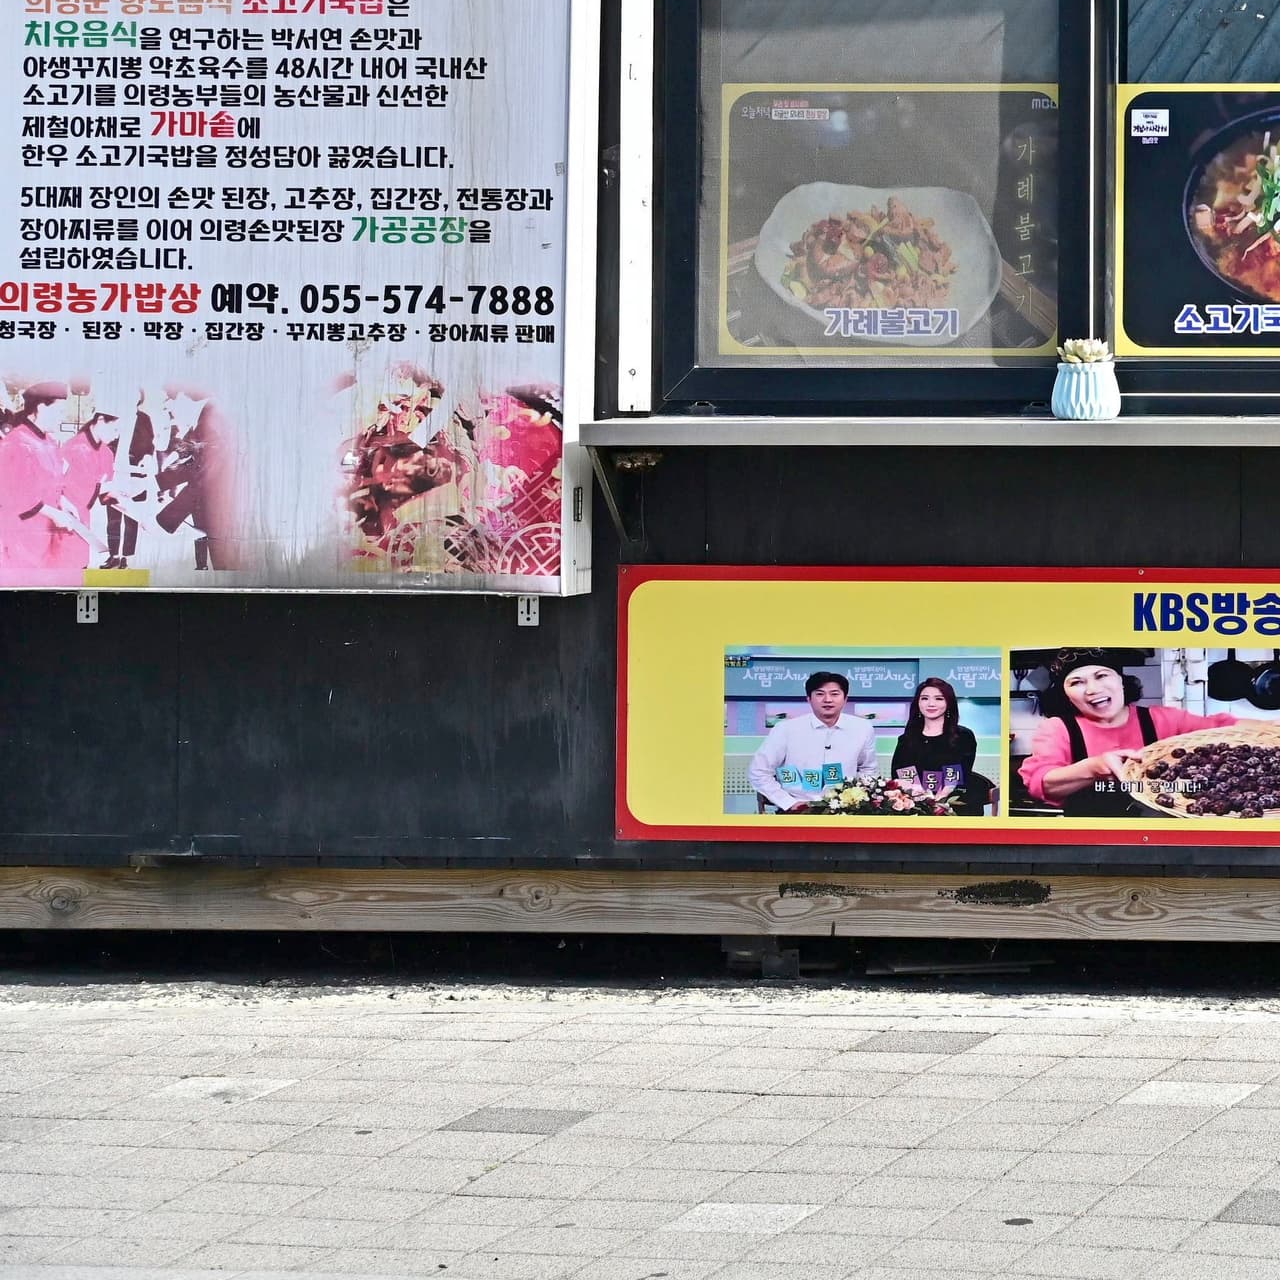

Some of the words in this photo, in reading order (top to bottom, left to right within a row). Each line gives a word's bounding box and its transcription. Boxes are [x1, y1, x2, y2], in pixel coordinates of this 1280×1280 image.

[24, 20, 162, 50] 치유음식을
[169, 28, 263, 50] 연구하는
[271, 28, 342, 50] 박서연
[349, 28, 422, 50] 손맛과
[23, 57, 142, 80] 야생꾸지뽕
[148, 57, 269, 80] 약초육수를
[275, 57, 352, 80] 48시간
[360, 57, 410, 80] 내어
[415, 57, 486, 80] 국내산
[23, 84, 117, 107] 소고기를
[123, 84, 266, 107] 의령농부들의
[273, 84, 370, 107] 농산물과
[377, 84, 448, 107] 신선한
[22, 115, 141, 139] 제철야채로
[150, 111, 261, 138] 가마솥에
[21, 144, 68, 169] 한우
[76, 144, 218, 169] 소고기국밥을
[224, 144, 321, 169] 정성담아
[328, 144, 454, 169] 끓였습니다.
[20, 187, 82, 210] 5대째
[89, 187, 160, 210] 장인의
[167, 187, 214, 210] 손맛
[221, 187, 277, 210] 된장,
[284, 187, 362, 210] 고추장,
[370, 187, 449, 210] 집간장,
[456, 187, 553, 210] 전통장과
[20, 219, 138, 242] 장아찌류를
[146, 219, 192, 242] 이어
[199, 219, 345, 242] 의령손맛된장
[351, 217, 492, 243] 가공공장을
[19, 247, 193, 271] 설립하였습니다.
[0, 282, 201, 313] 의령농가밥상
[300, 284, 554, 316] 055-574-7888
[0, 322, 56, 341] 청국장
[82, 322, 122, 341] 된장
[143, 322, 183, 341] 막장
[205, 322, 265, 341] 집간장
[286, 323, 406, 342] 꾸지뽕고추장
[428, 324, 507, 343] 장아찌류
[515, 325, 555, 344] 판매
